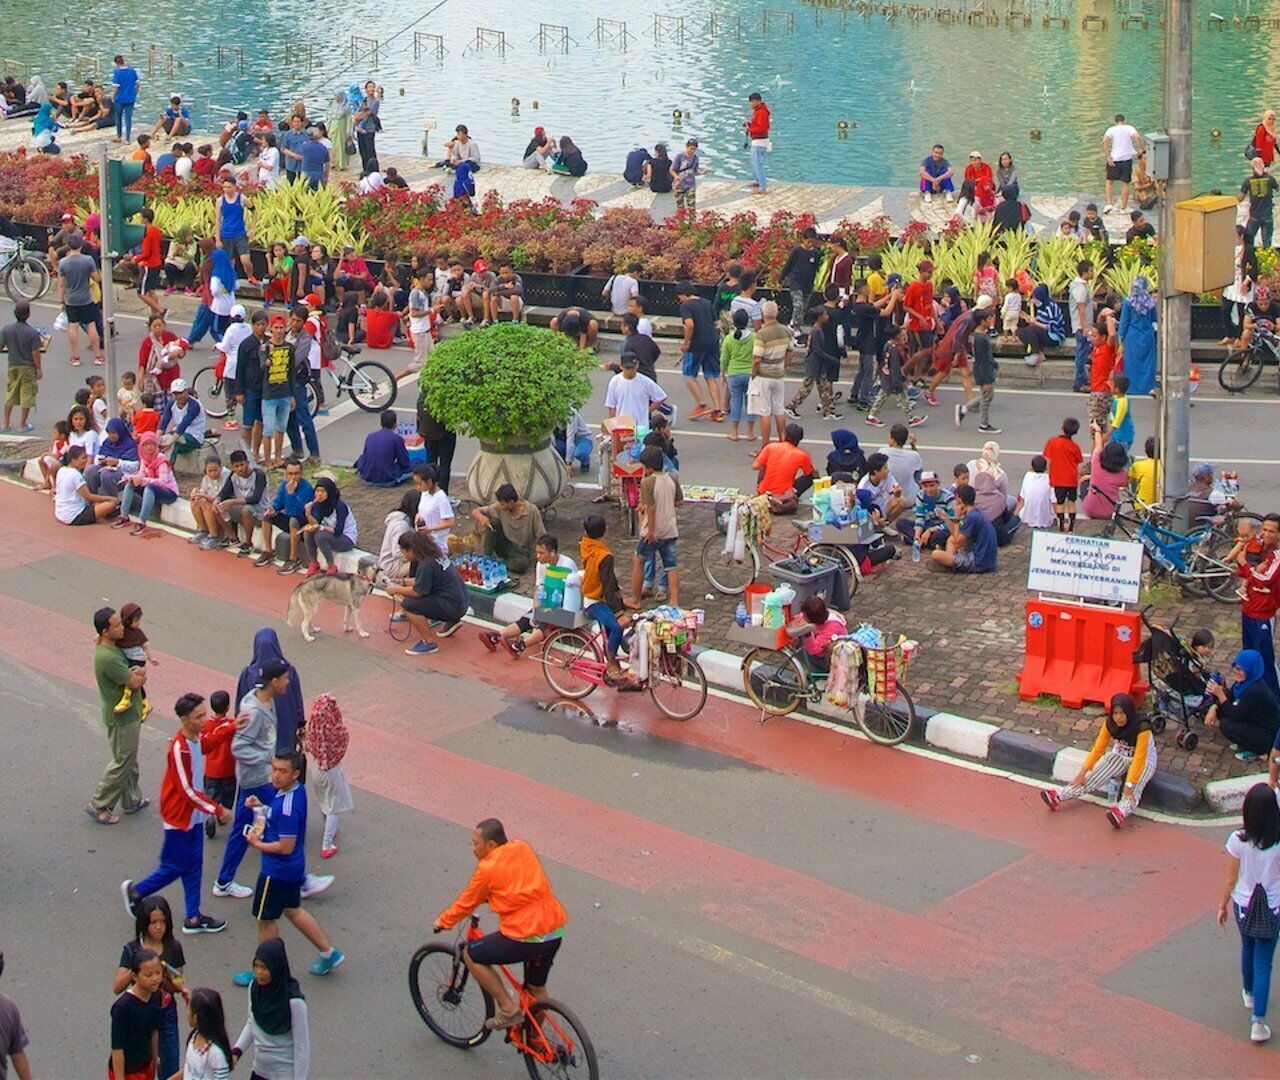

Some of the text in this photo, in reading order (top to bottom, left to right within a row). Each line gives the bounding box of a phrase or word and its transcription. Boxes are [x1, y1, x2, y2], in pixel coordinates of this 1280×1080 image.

[1046, 546, 1081, 557] PEJALAN
[1031, 567, 1138, 586] JEMBATAN PENYEBRANGAN
